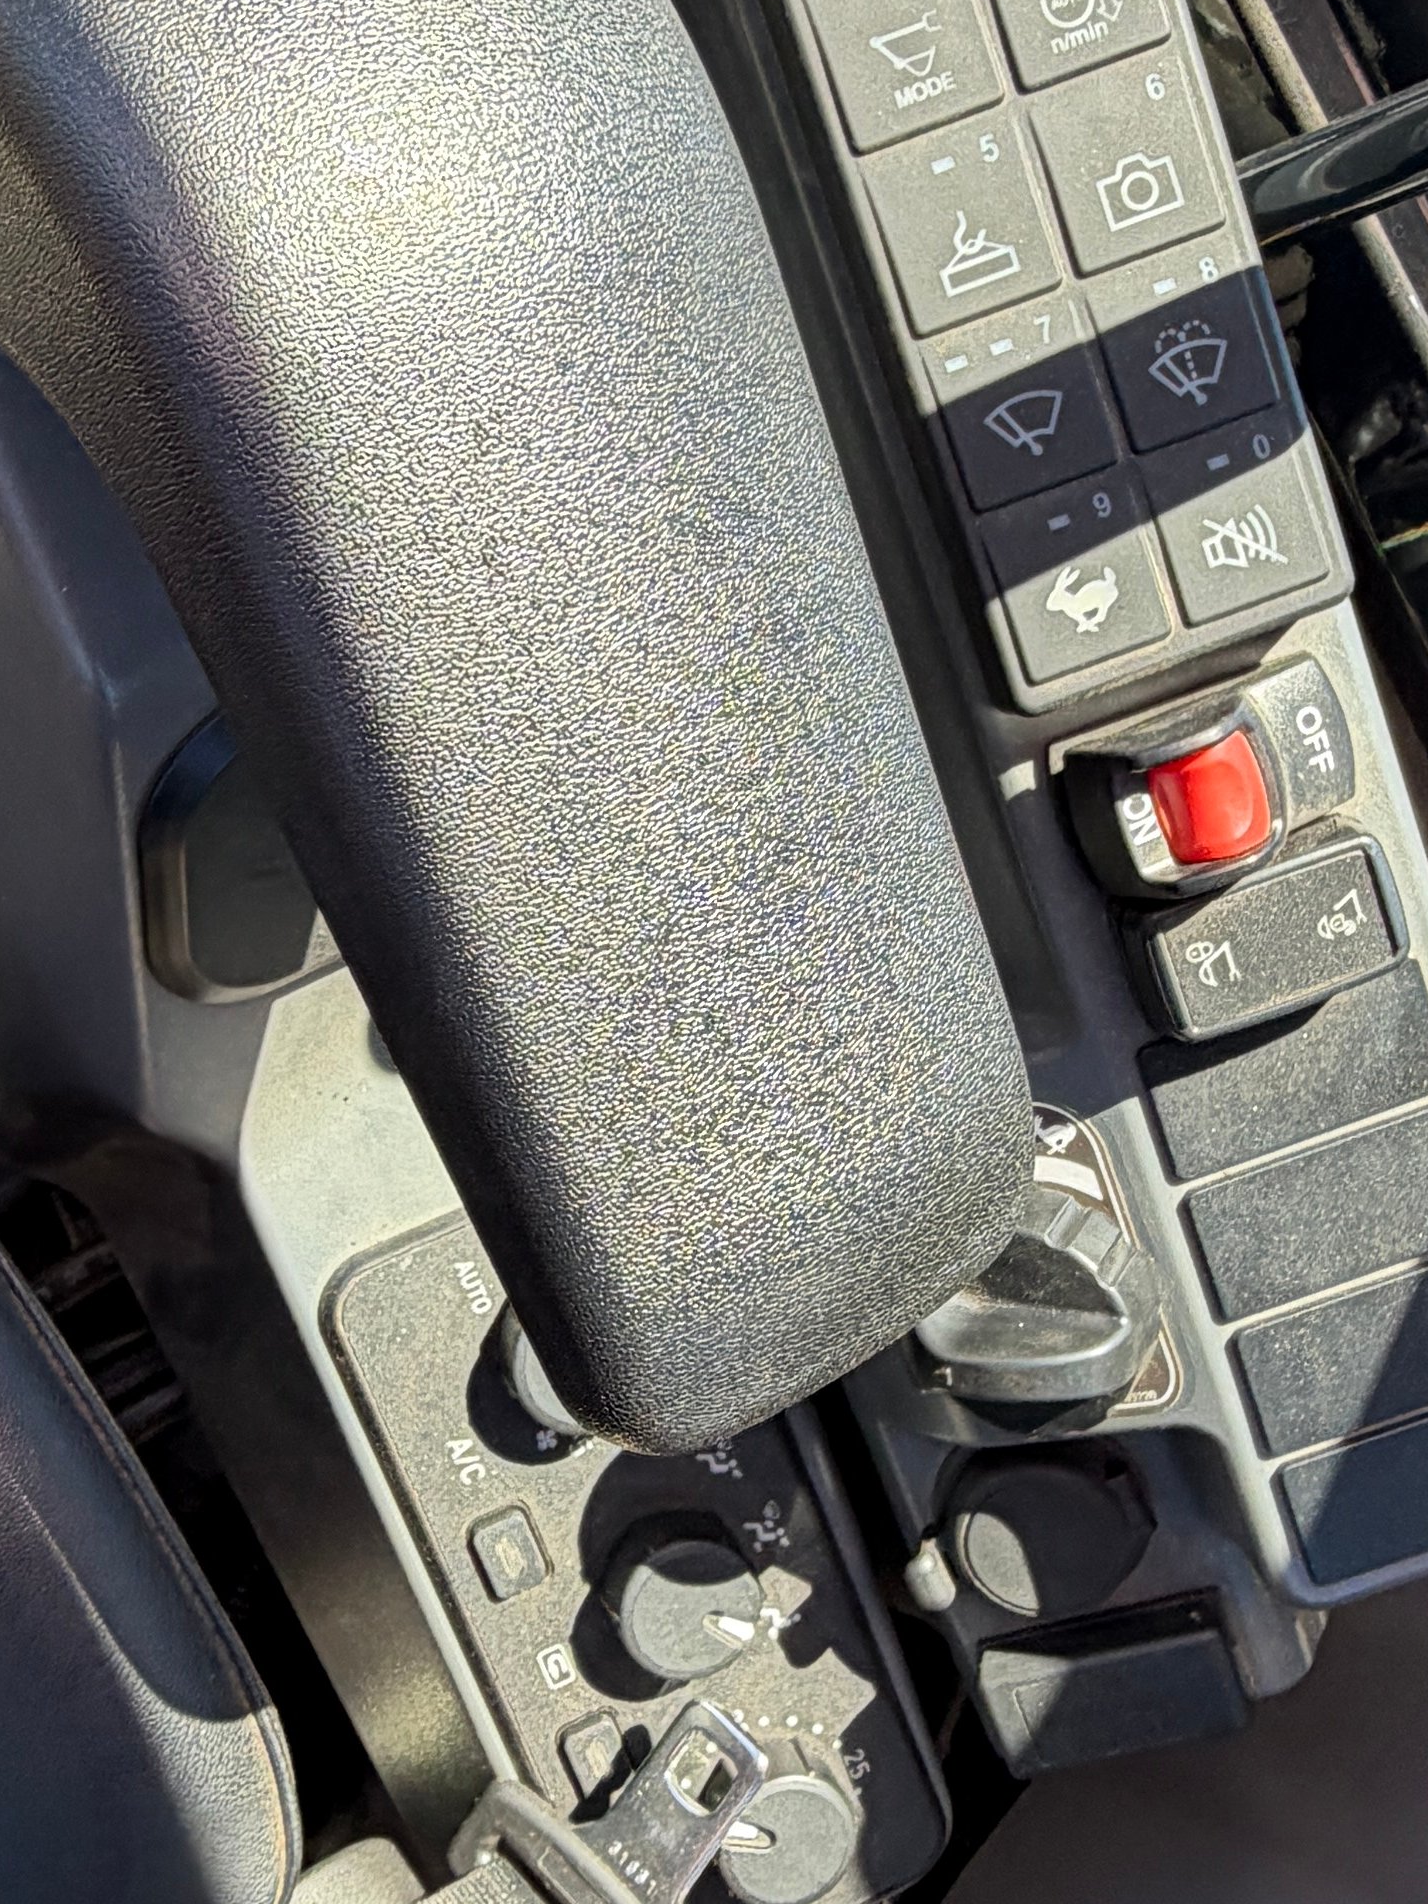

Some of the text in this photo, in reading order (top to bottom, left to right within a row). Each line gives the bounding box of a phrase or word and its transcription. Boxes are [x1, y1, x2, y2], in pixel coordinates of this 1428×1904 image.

[1050, 21, 1109, 54] n/min
[894, 69, 956, 108] MODE
[1145, 72, 1166, 101] 6
[979, 133, 999, 164] 5
[1200, 257, 1220, 282] 8
[1033, 315, 1052, 343] 7
[1252, 434, 1271, 460] 0
[1092, 493, 1112, 518] 9
[1295, 705, 1336, 775] OFF
[1122, 792, 1162, 847] ON
[453, 1260, 493, 1316] AUTO
[445, 1437, 486, 1486] A/C
[844, 1748, 871, 1780] 25
